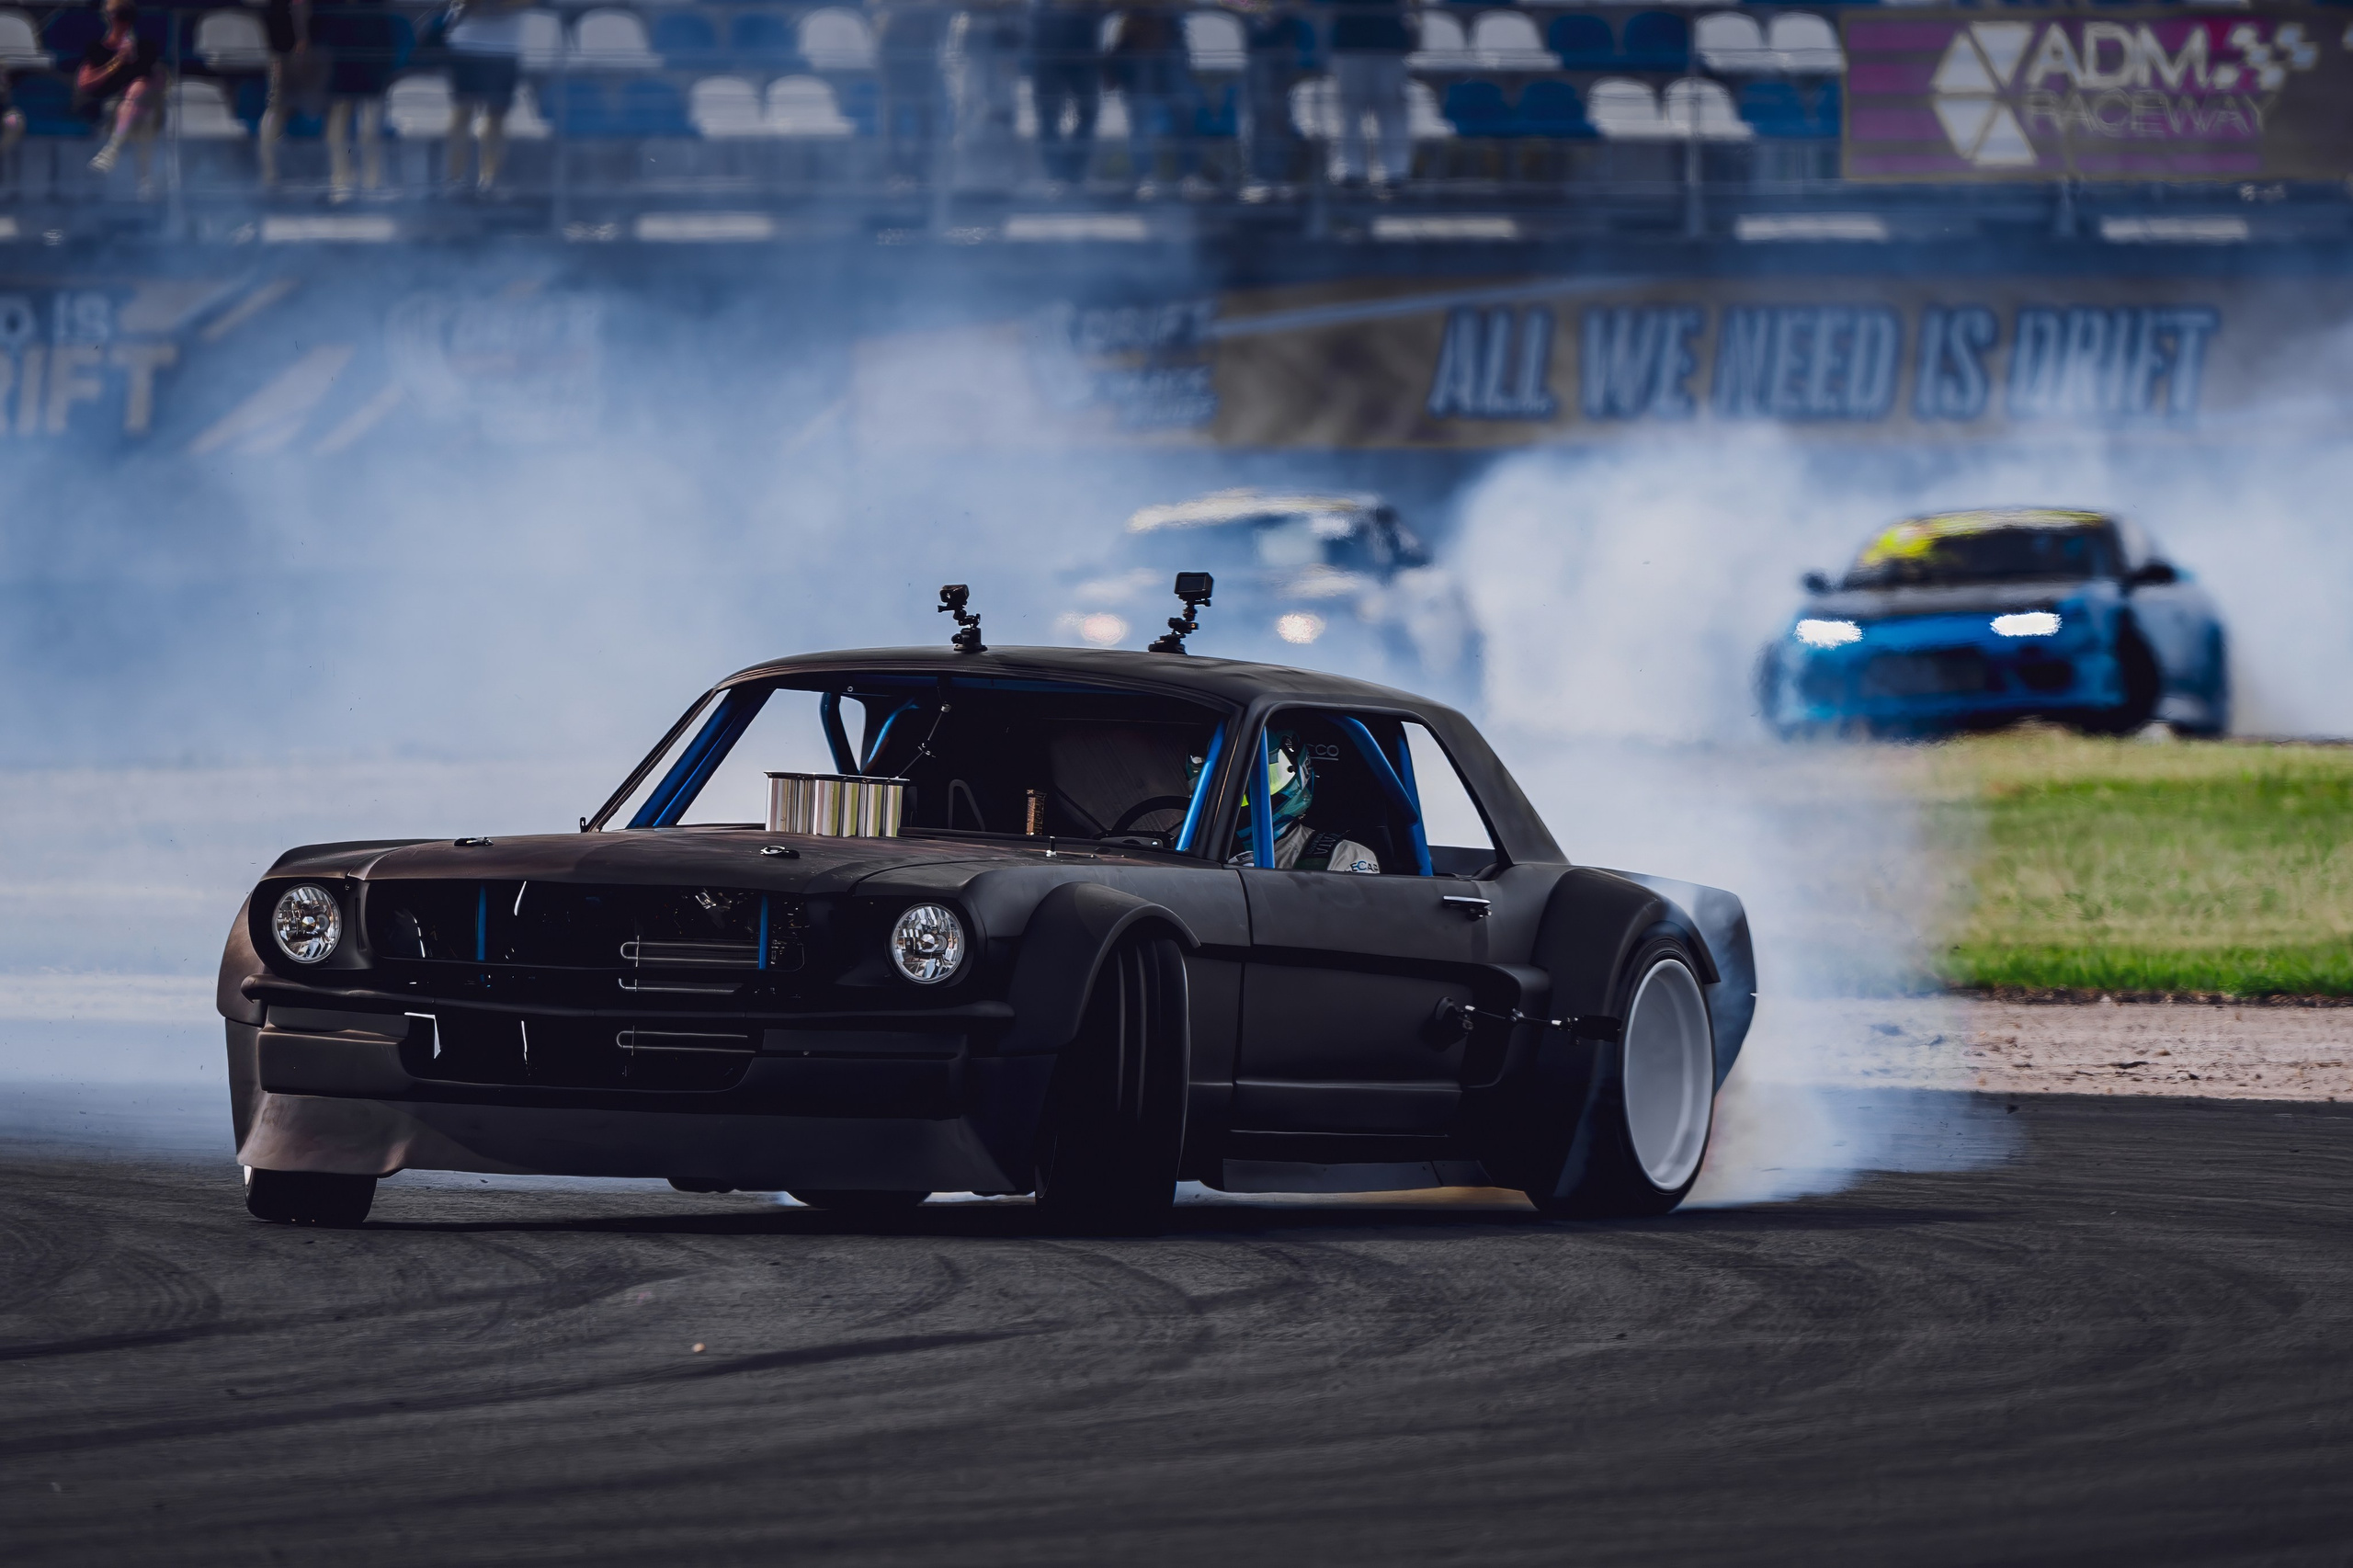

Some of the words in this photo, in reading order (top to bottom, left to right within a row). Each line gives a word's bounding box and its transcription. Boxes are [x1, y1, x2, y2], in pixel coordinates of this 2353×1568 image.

[2028, 90, 2278, 136] RACEWAY
[53, 291, 108, 343] IS
[0, 342, 178, 436] IFT
[1427, 305, 1555, 418] ALL
[1582, 305, 1702, 417] WE
[1715, 305, 1899, 419] NEED
[1917, 307, 1997, 419] IS
[2010, 307, 2217, 425] DRIFT
